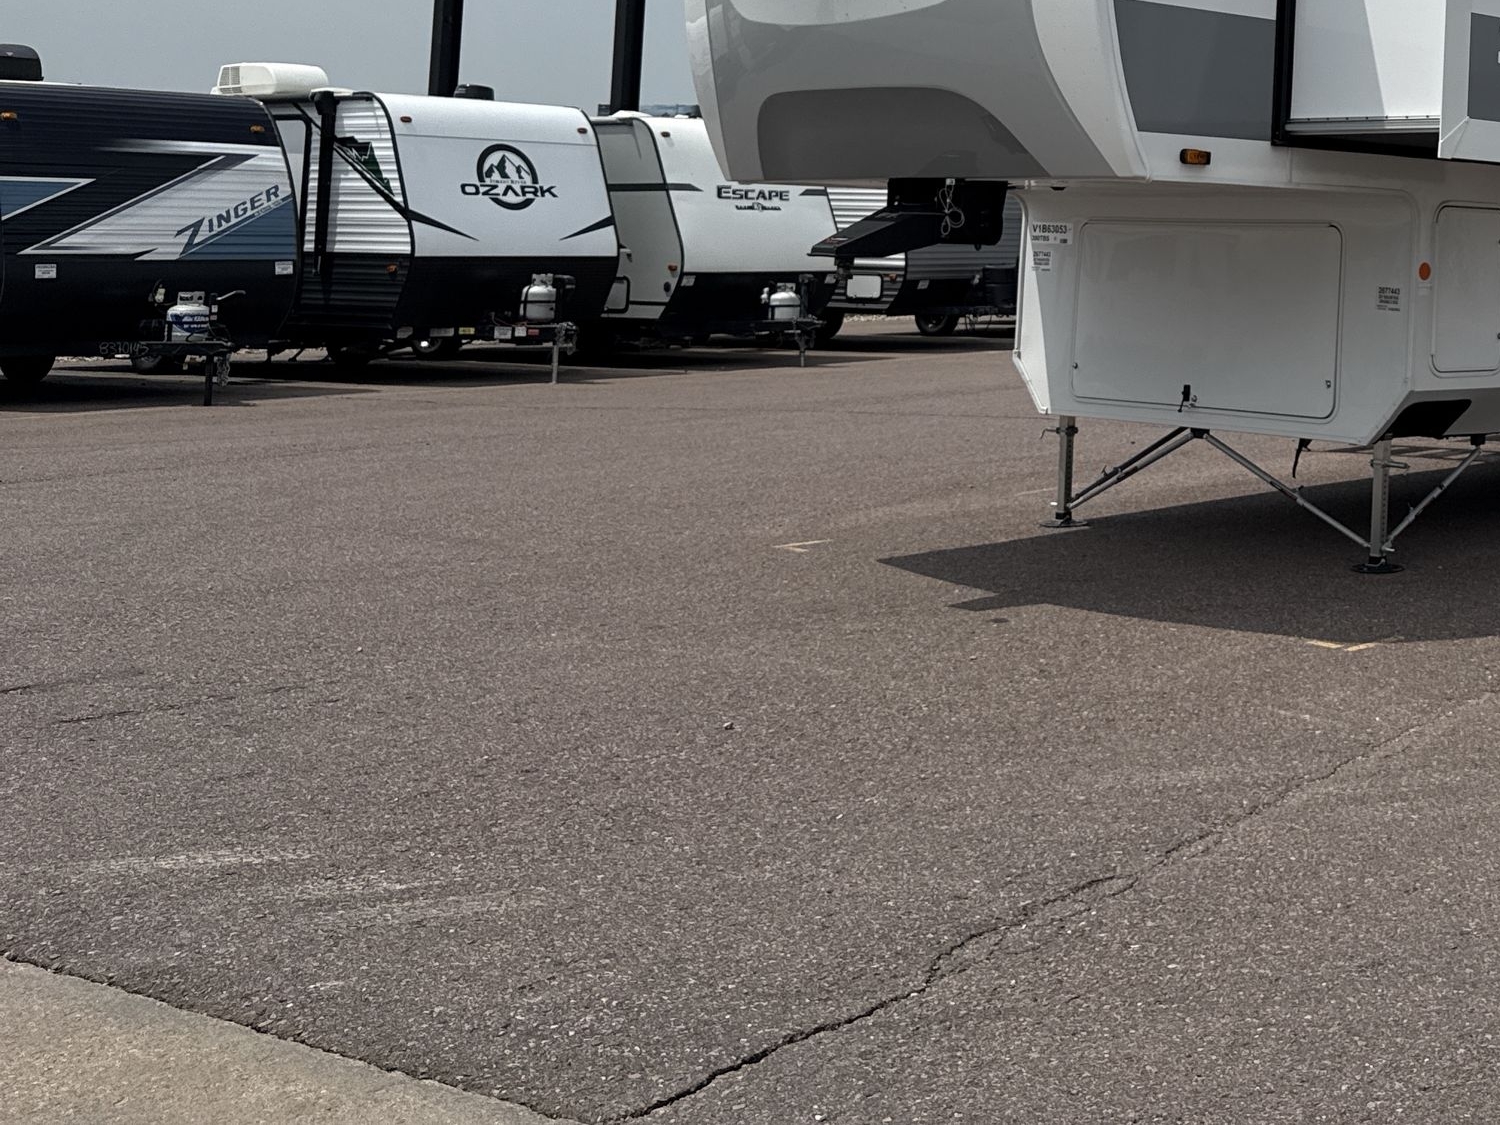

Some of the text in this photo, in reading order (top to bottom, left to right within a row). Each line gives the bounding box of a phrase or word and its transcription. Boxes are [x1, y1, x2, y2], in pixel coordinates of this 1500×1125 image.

[460, 183, 559, 198] OZARK
[716, 185, 790, 201] ESCAPE
[174, 184, 280, 256] ZINGER
